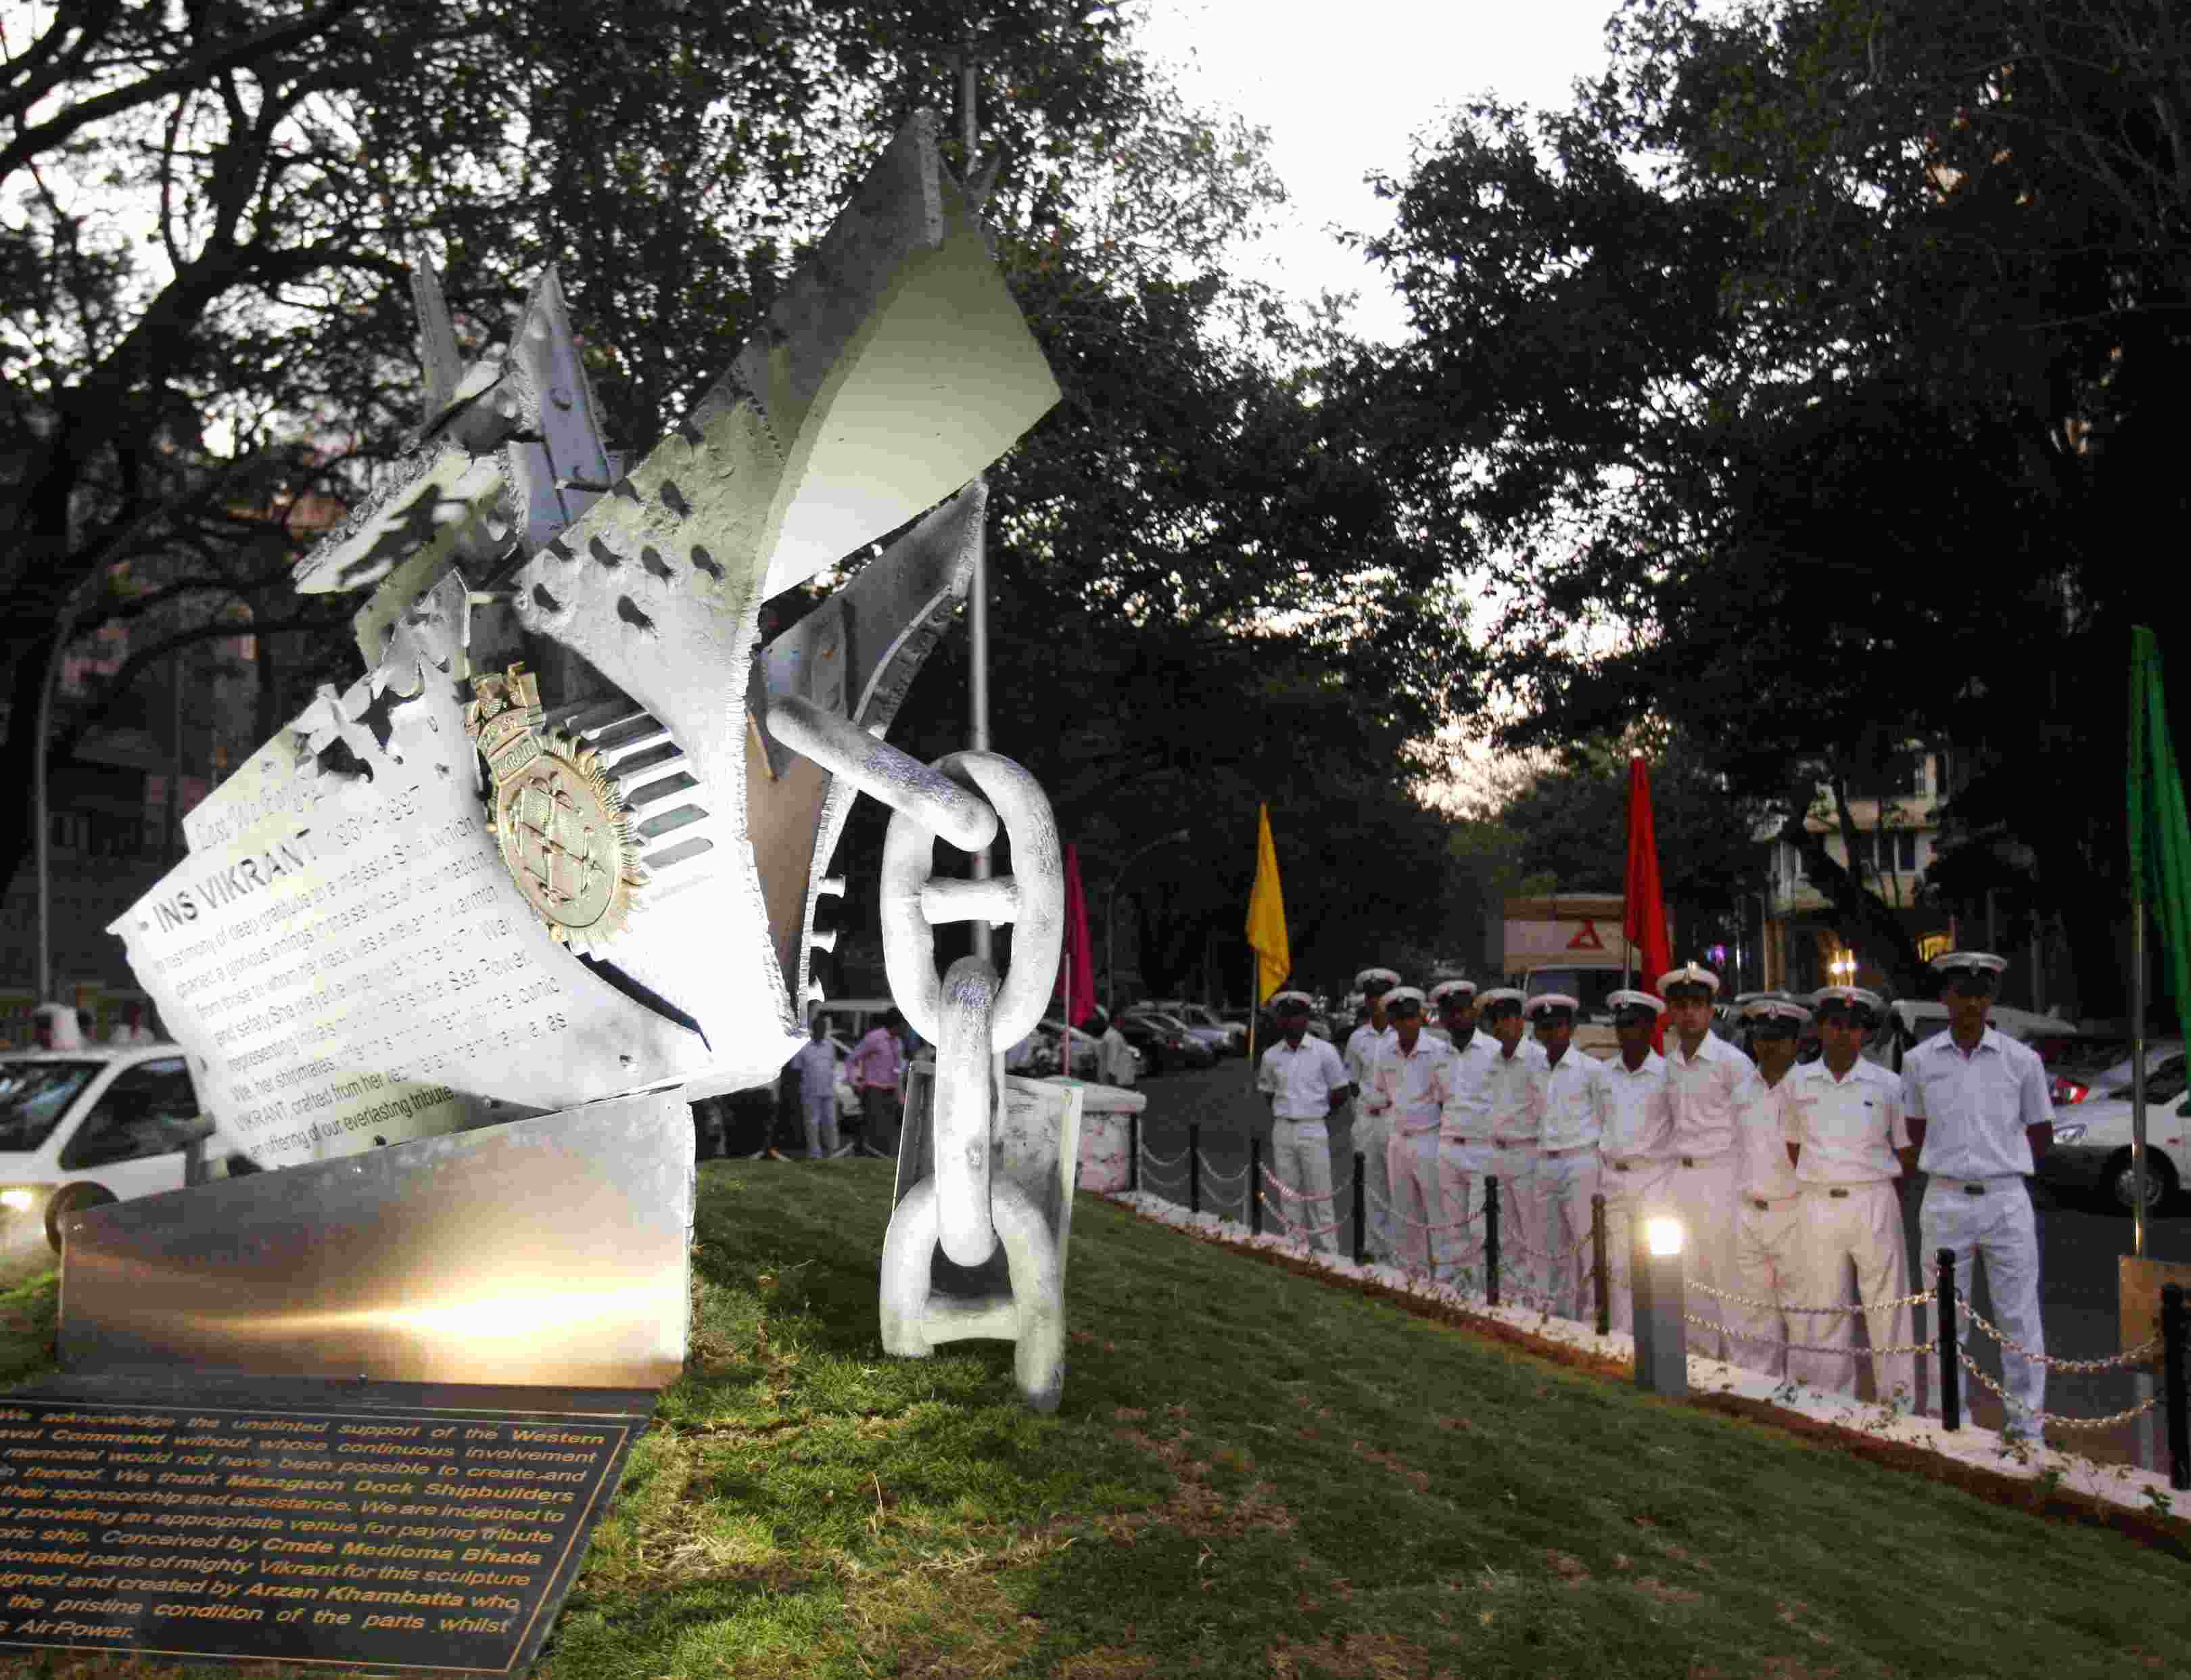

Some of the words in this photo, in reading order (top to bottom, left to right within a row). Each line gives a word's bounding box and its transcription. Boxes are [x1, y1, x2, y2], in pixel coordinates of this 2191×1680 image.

[151, 888, 200, 934] INS
[194, 827, 323, 912] VIKRANT
[227, 914, 263, 943] deep
[222, 941, 273, 981] glorious
[288, 1086, 334, 1117] crafted
[328, 1074, 364, 1102] from
[357, 1065, 387, 1093] her
[304, 1121, 325, 1142] of
[320, 1118, 345, 1139] our
[341, 1098, 414, 1134] everlasting
[51, 1428, 167, 1445] Command
[173, 1434, 252, 1450] without
[259, 1439, 328, 1451] whose
[336, 1442, 456, 1457] continuous
[465, 1445, 598, 1462] involvement
[186, 1418, 219, 1428] the
[336, 1424, 422, 1438] support
[429, 1426, 458, 1439] of
[465, 1428, 498, 1439] the
[512, 1428, 607, 1445] Western
[108, 1449, 173, 1464] would
[176, 1453, 216, 1466] not
[278, 1456, 333, 1472] been
[337, 1461, 431, 1476] possible
[438, 1465, 459, 1477] to
[465, 1466, 537, 1480] create
[541, 1470, 588, 1483] and
[114, 1470, 151, 1483] We
[157, 1471, 222, 1487] thank
[226, 1474, 346, 1493] Mazagaon
[354, 1480, 416, 1493] Dock
[423, 1483, 574, 1504] Shipbuilders
[52, 1489, 183, 1506] sponsorship
[185, 1493, 232, 1506] and
[360, 1500, 397, 1514] We
[399, 1503, 438, 1514] are
[440, 1503, 542, 1520] indebted
[544, 1510, 566, 1522] to
[15, 1507, 119, 1525] providing
[122, 1512, 152, 1523] an
[154, 1514, 283, 1531] appropriate
[290, 1520, 358, 1533] venue
[362, 1522, 398, 1537] for
[398, 1525, 476, 1541] paying
[102, 1530, 222, 1549] Conceived
[225, 1536, 259, 1552] by
[262, 1537, 335, 1554] Cmde
[461, 1547, 542, 1564] Bhada
[83, 1555, 146, 1568] parts
[149, 1555, 177, 1569] of
[173, 1557, 254, 1574] mighty
[260, 1558, 341, 1576] Vikrant
[342, 1564, 378, 1579] for
[378, 1565, 419, 1581] this
[421, 1568, 530, 1587] sculpture
[66, 1574, 116, 1589] and
[117, 1578, 208, 1592] created
[210, 1580, 241, 1598] by
[243, 1582, 319, 1598] Arzan
[325, 1586, 466, 1607] Khambatta
[7, 1593, 45, 1610] the
[53, 1597, 144, 1614] pristine
[152, 1603, 265, 1620] condition
[276, 1607, 307, 1623] of
[312, 1608, 352, 1625] the
[361, 1612, 426, 1629] parts
[441, 1616, 510, 1635] whilst
